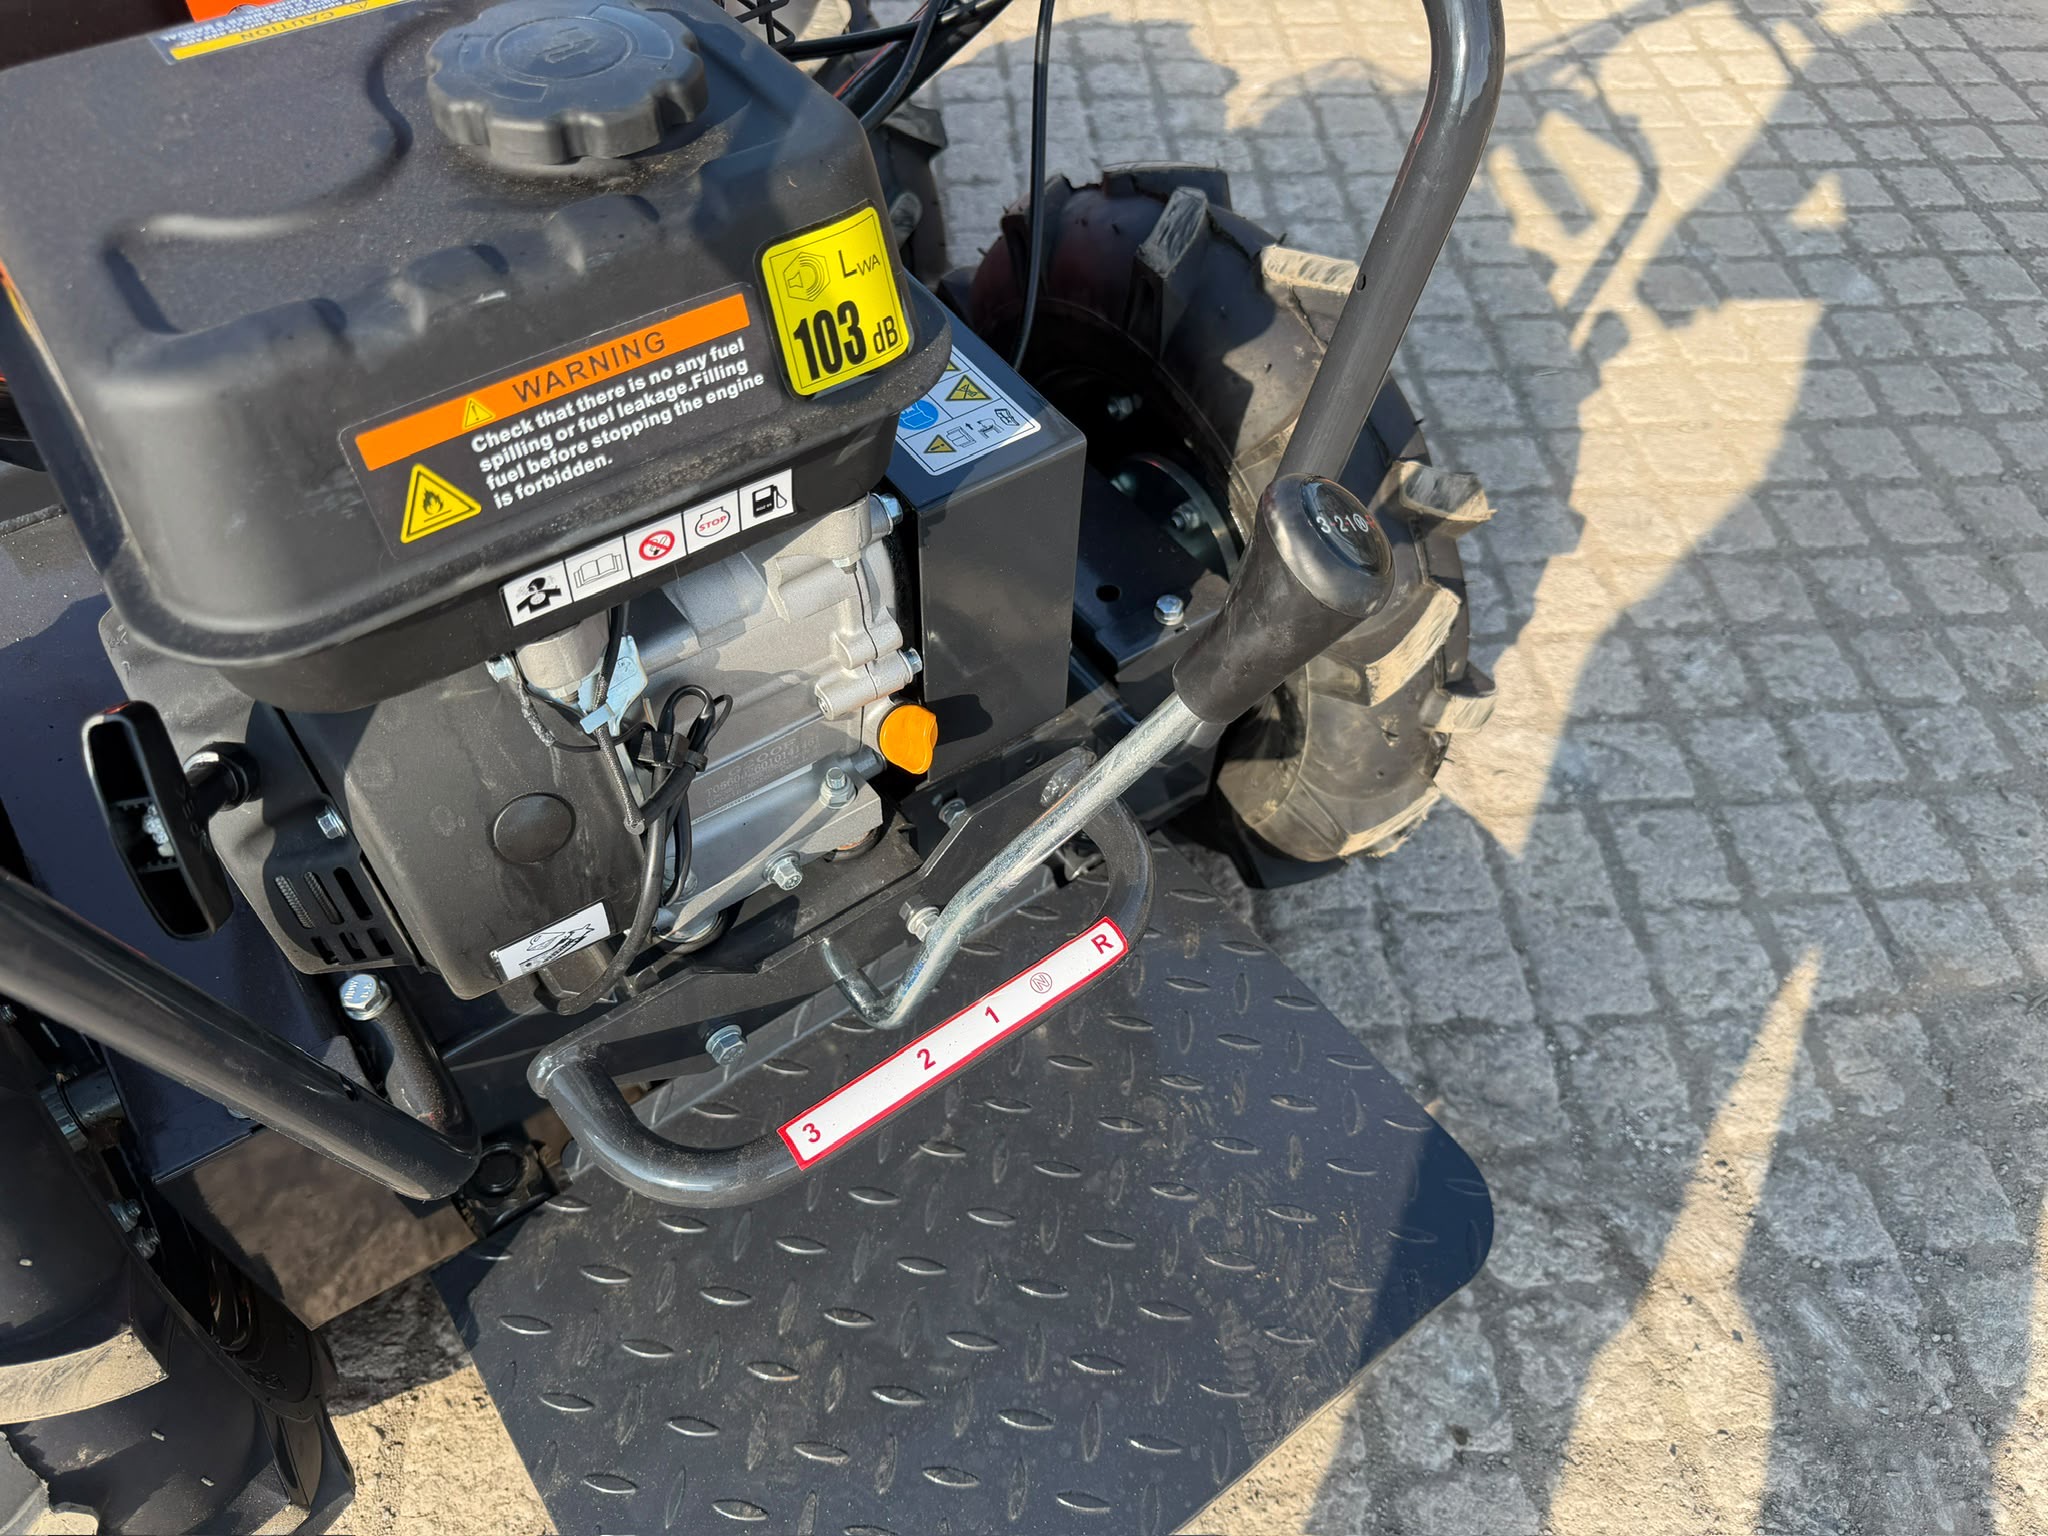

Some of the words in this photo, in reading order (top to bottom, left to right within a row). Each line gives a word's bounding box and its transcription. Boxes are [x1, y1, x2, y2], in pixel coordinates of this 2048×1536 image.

[240, 11, 334, 40] CAUTION
[512, 331, 666, 403] WARNING
[793, 300, 867, 381] 103
[873, 315, 898, 354] dB
[471, 418, 535, 453] Check
[535, 401, 575, 429] that
[575, 385, 626, 413] there
[627, 377, 647, 393] is
[649, 367, 673, 386] no
[675, 353, 707, 375] any
[709, 336, 746, 362] fuel
[479, 433, 553, 472] spilling
[555, 422, 575, 441] or
[577, 406, 616, 433] fuel
[486, 463, 525, 491] fuel
[526, 440, 589, 475] before
[591, 408, 673, 449] stopping
[674, 396, 704, 417] the
[705, 373, 765, 404] engine
[493, 490, 514, 510] is
[515, 454, 613, 500] forbidden.
[698, 515, 727, 532] STOP
[801, 1122, 822, 1144] 3
[916, 1048, 937, 1071] 2
[984, 1006, 1001, 1024] 1
[1091, 933, 1115, 955] R
